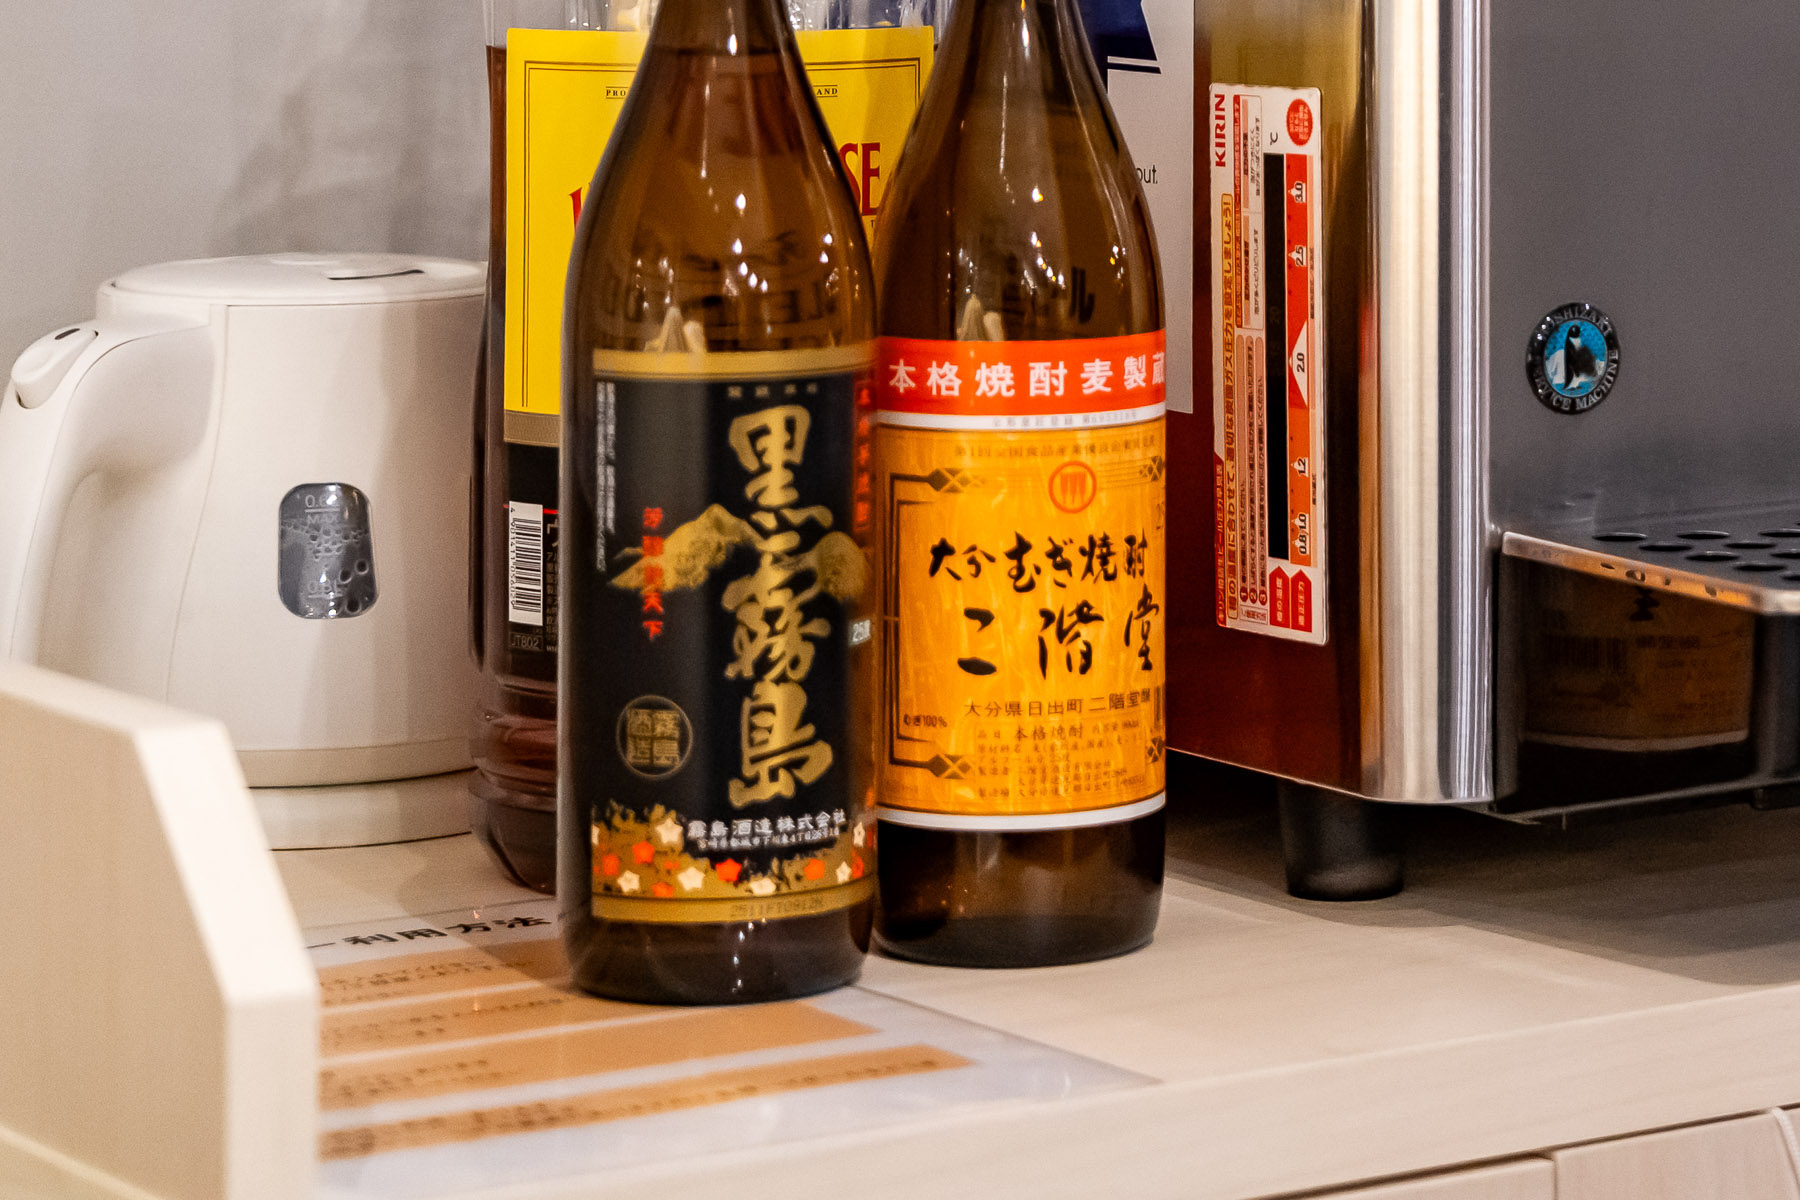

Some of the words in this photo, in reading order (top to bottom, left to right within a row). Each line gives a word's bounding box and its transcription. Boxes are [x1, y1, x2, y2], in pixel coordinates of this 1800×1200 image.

[606, 89, 627, 97] PRO
[1214, 94, 1225, 167] KIRIN
[838, 142, 882, 217] SE
[1295, 182, 1303, 202] 3.0
[1296, 246, 1304, 266] 2.5
[1296, 352, 1304, 373] 2.0
[1575, 349, 1619, 411] MACHINE
[1298, 458, 1306, 475] 1.2
[928, 529, 1148, 593] 大分むぎ焼酎
[721, 404, 834, 810] 黒霧島
[956, 583, 1161, 680] 二階堂
[964, 698, 1083, 717] 大分県日出町
[1014, 723, 1084, 741] 本格焼酎
